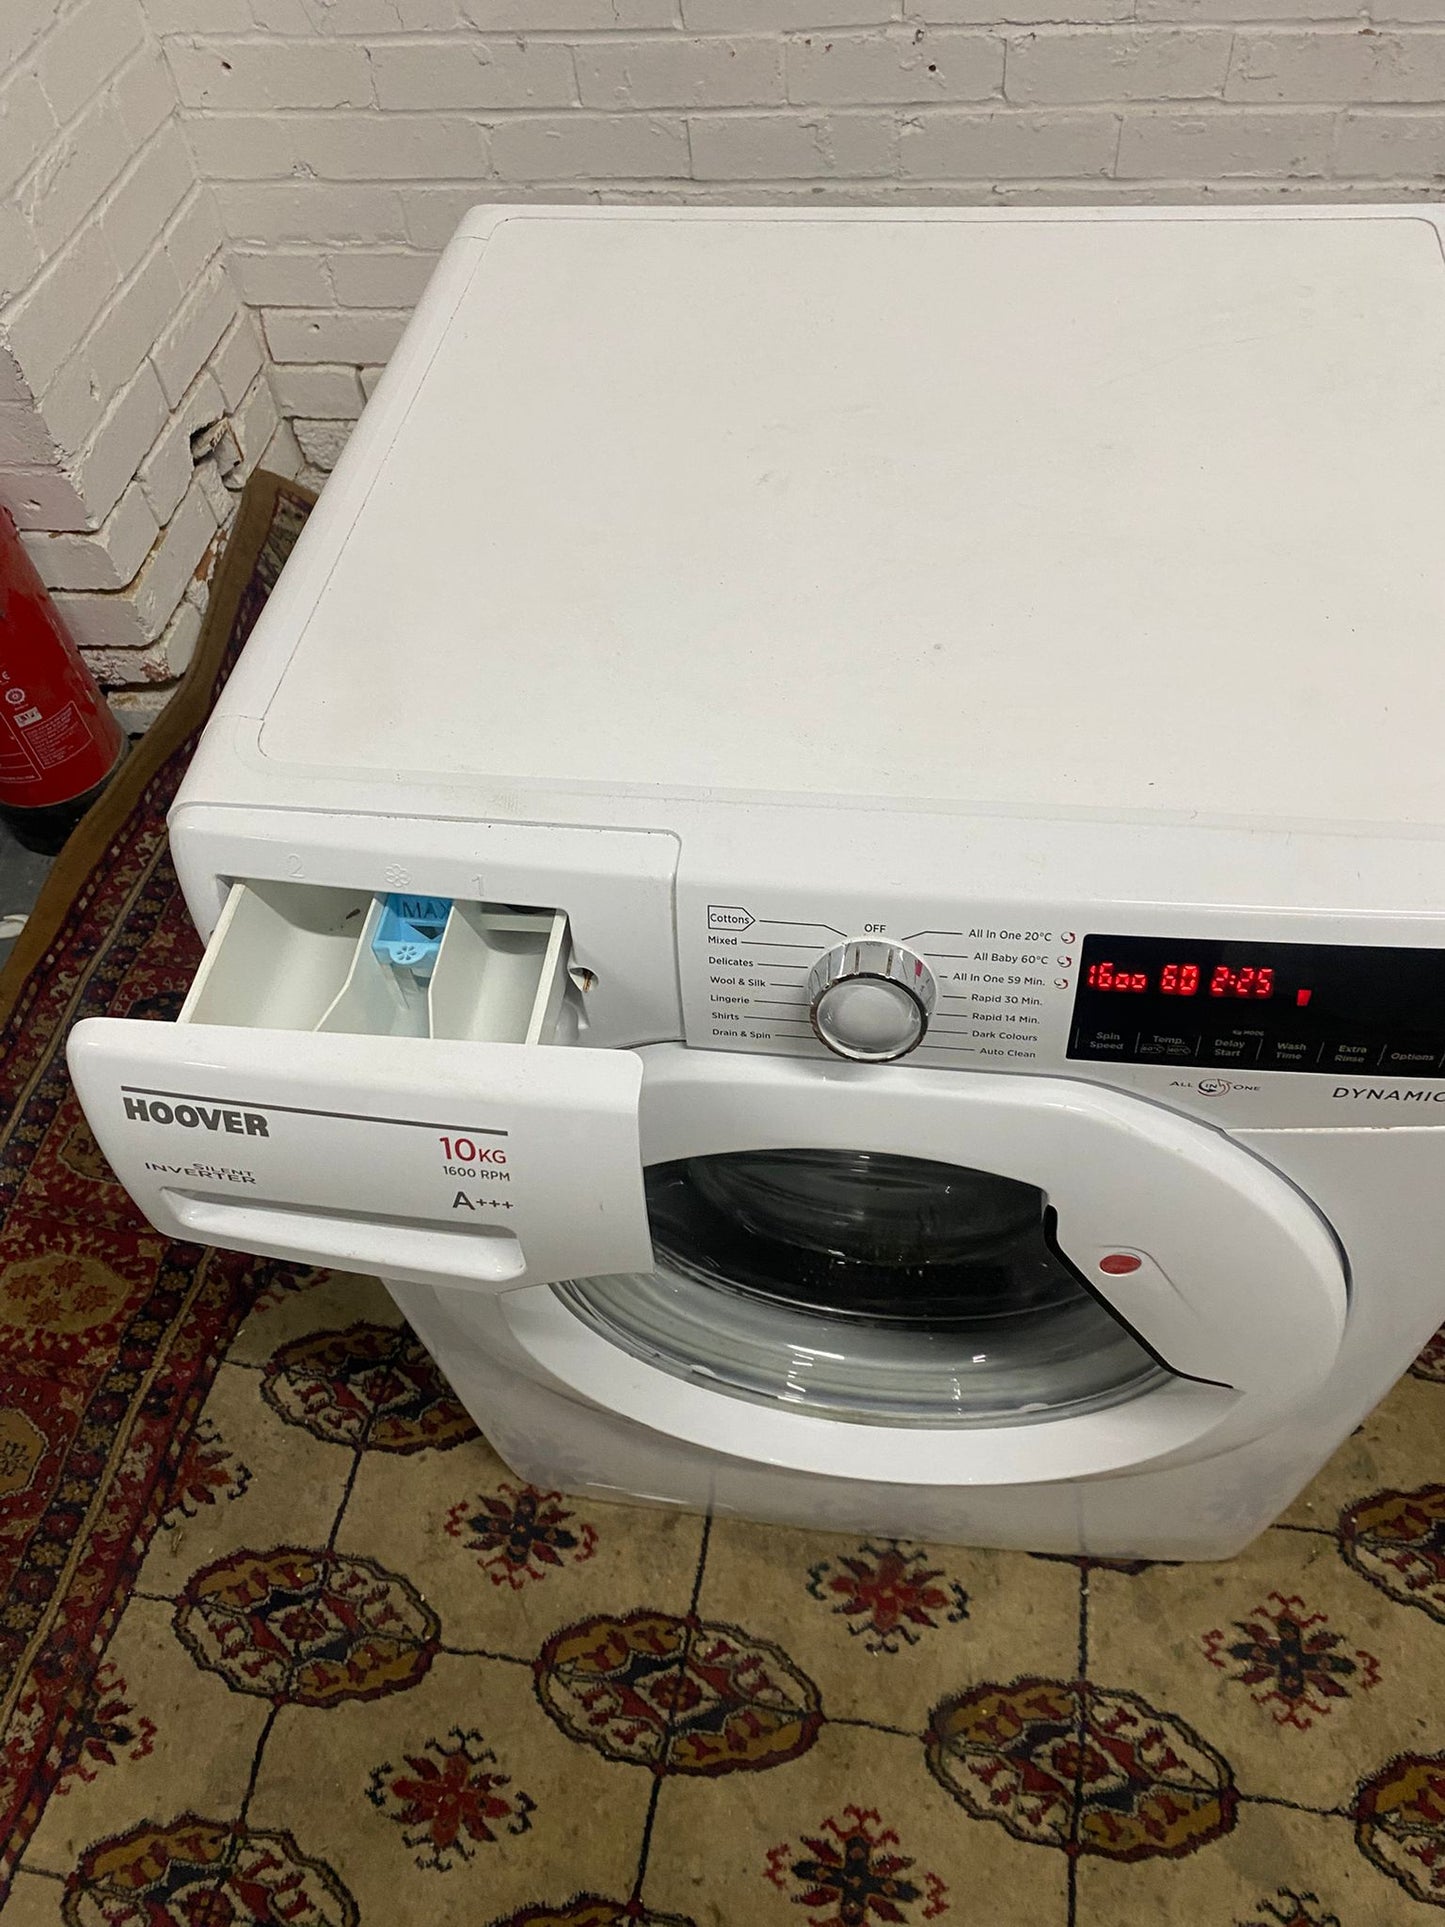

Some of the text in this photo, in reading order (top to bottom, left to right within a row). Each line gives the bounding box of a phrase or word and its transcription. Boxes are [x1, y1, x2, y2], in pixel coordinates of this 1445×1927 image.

[710, 913, 750, 924] Cottons
[864, 924, 886, 933] OFF
[708, 935, 738, 946] Mixed
[969, 929, 1052, 941] All In One 20°C
[708, 956, 754, 967] Delicates
[974, 952, 1049, 964] All Baby 60°C
[710, 976, 766, 987] Wool & Silk
[953, 973, 1046, 986] All In One 59 Min.
[1211, 966, 1273, 994] 2:25
[710, 994, 750, 1004] Lingerie
[971, 994, 1043, 1006] Rapid 30 Min.
[712, 1012, 740, 1020] Shirts
[972, 1012, 1040, 1024] Rapid 14 Min.
[712, 1028, 771, 1039] Drain & Spin
[972, 1030, 1038, 1041] Dark Colours
[1096, 1031, 1120, 1040] Spin
[1090, 1041, 1124, 1050] Speed
[1153, 1035, 1186, 1045] Temp.
[1215, 1039, 1246, 1049] Delay
[1277, 1042, 1306, 1051] Wash
[1338, 1044, 1367, 1053] Extra
[980, 1047, 1036, 1058] Auto Clean
[1214, 1048, 1241, 1057] Start
[1276, 1051, 1302, 1060] Time
[1391, 1052, 1435, 1061] Options
[1334, 1054, 1365, 1063] Rinse
[123, 1097, 270, 1137] HOOVER
[439, 1136, 507, 1164] 10KG
[145, 1162, 257, 1184] INVERTER
[192, 1163, 253, 1177] SILENT
[443, 1165, 511, 1181] 1600 RPM
[452, 1191, 514, 1210] A+++
